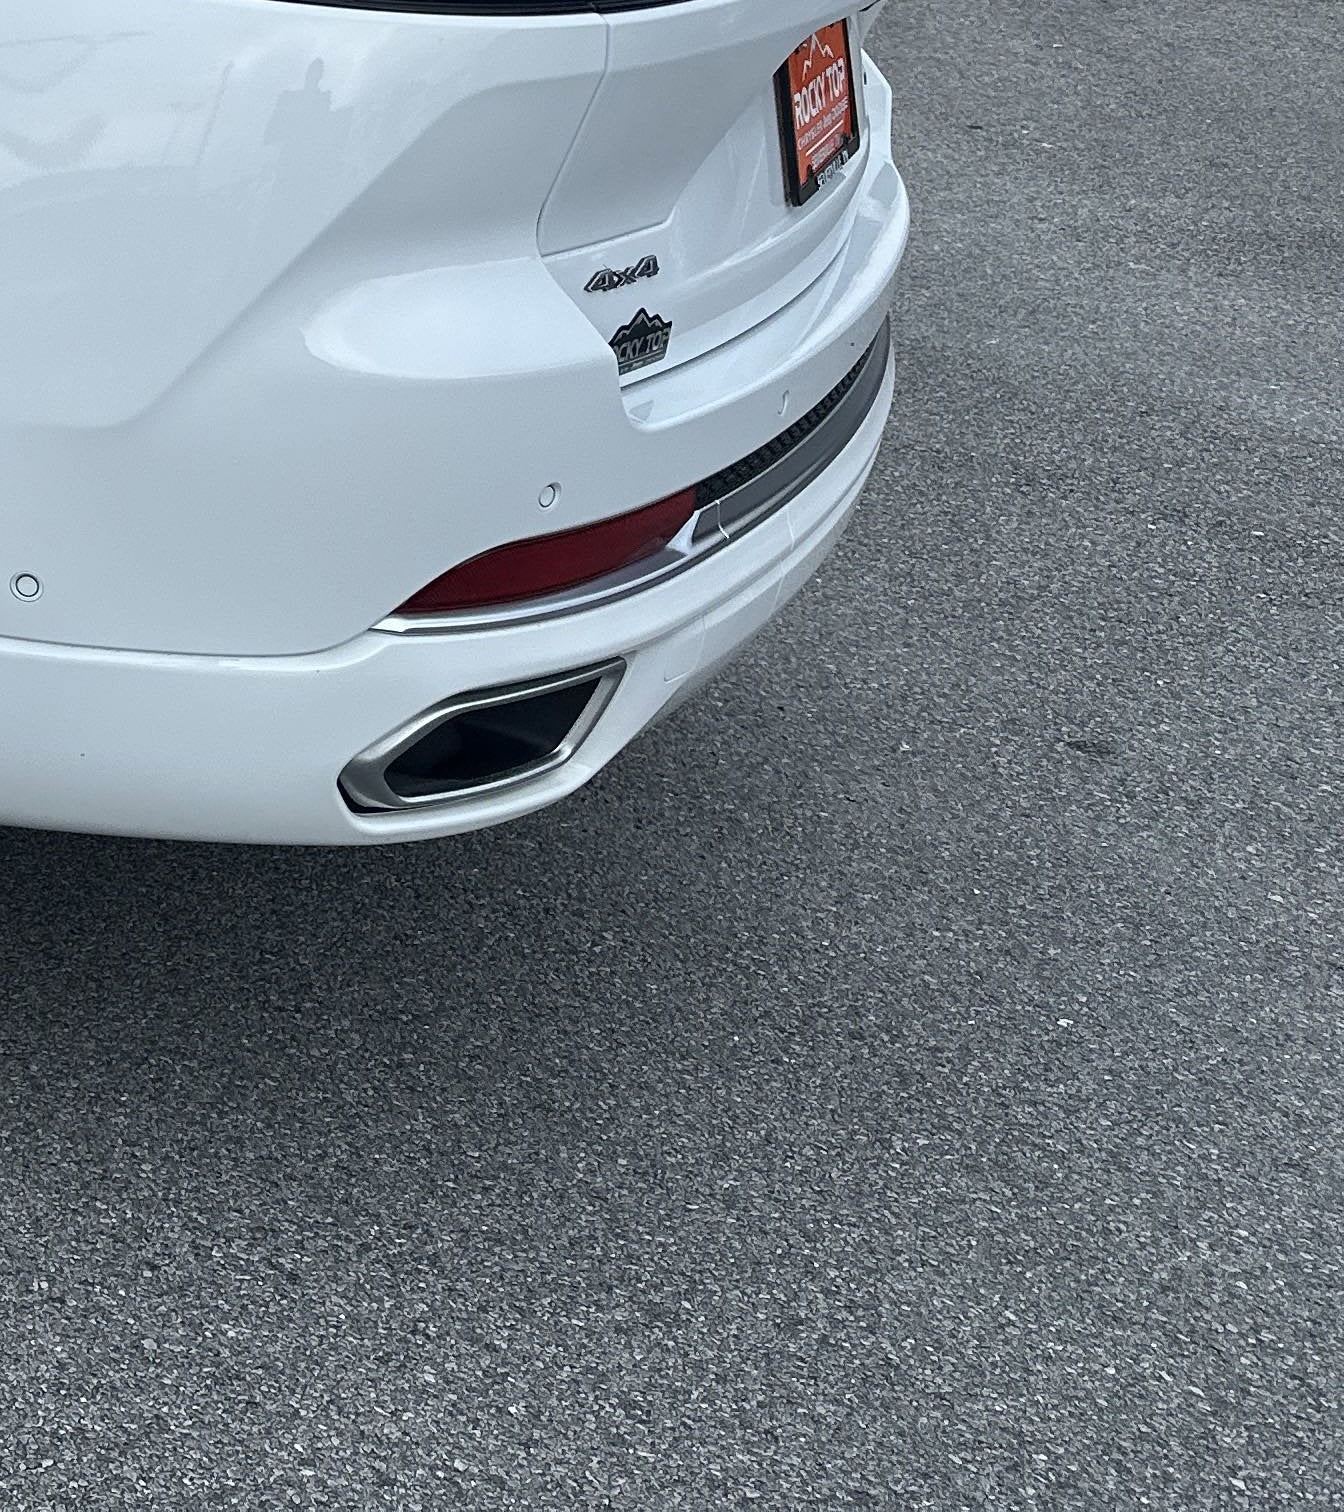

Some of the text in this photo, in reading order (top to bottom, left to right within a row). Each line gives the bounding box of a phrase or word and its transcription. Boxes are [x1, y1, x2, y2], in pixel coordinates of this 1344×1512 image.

[793, 57, 846, 130] ROCKY TOP
[584, 254, 660, 292] 4x4
